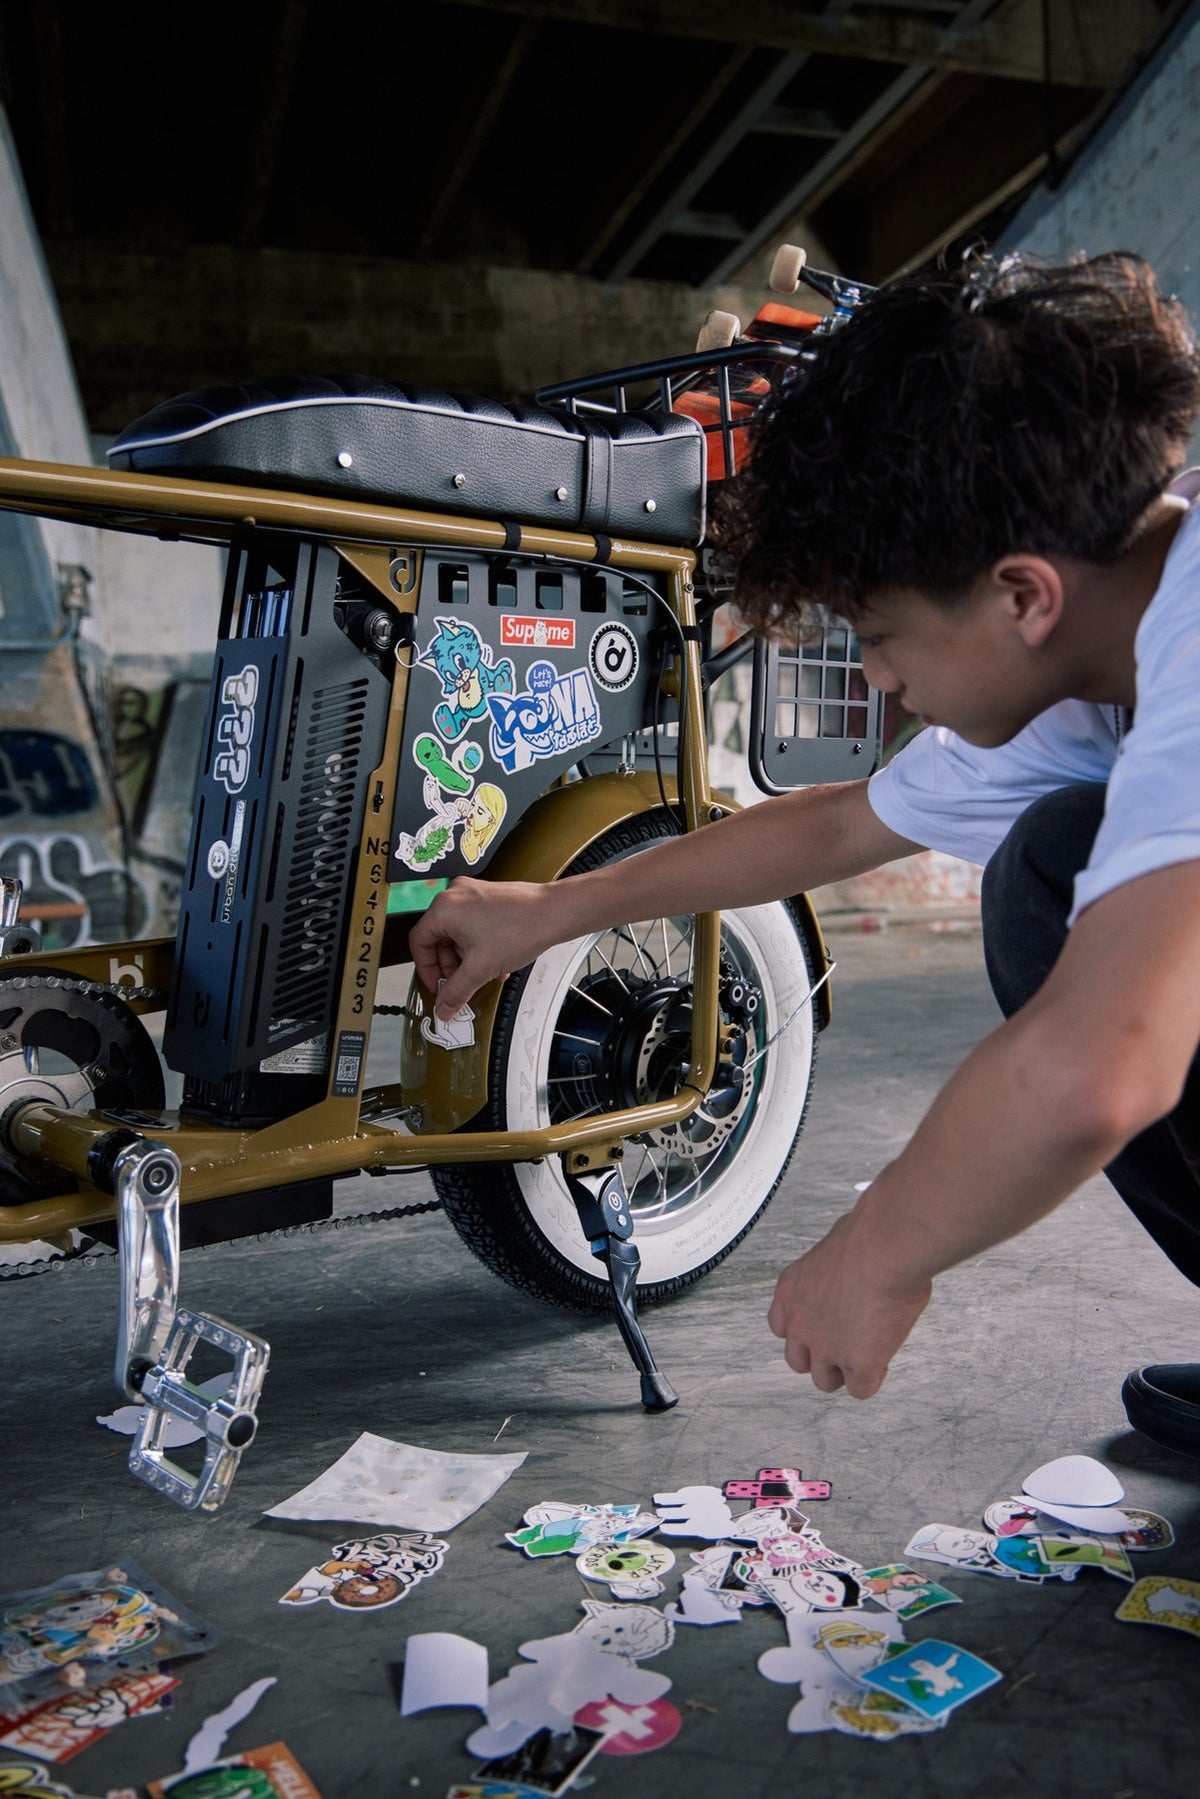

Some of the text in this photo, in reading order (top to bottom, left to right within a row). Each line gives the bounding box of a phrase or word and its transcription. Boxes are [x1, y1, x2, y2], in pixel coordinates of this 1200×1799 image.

[506, 618, 570, 644] Supme
[533, 668, 553, 679] Let's
[533, 678, 553, 689] race!
[584, 1544, 666, 1579] LATER NERDS
